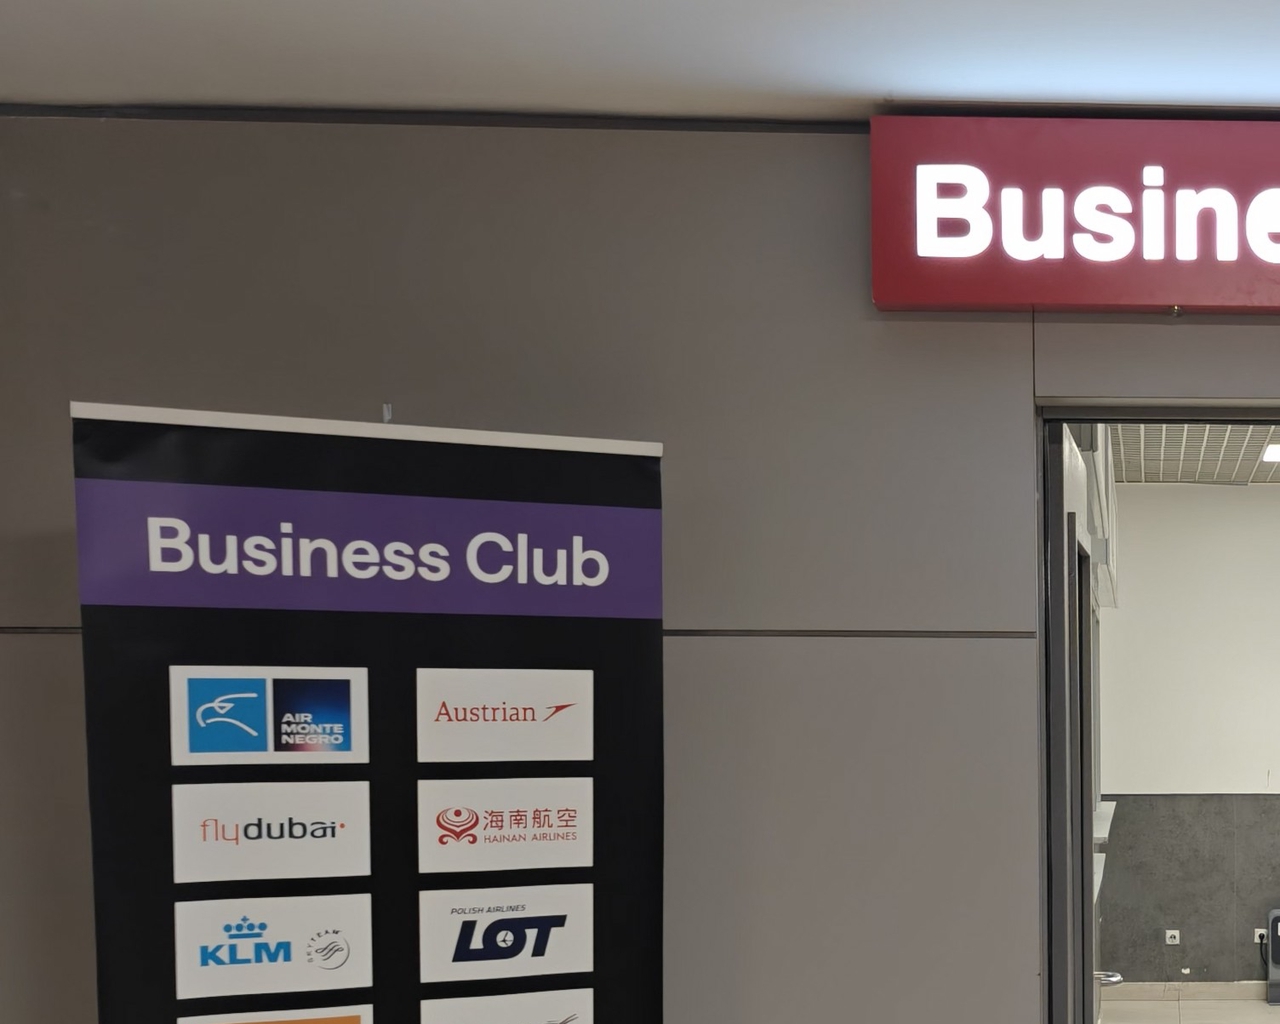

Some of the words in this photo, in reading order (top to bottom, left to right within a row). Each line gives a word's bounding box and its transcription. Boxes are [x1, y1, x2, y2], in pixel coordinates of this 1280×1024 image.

[147, 516, 451, 581] Business
[467, 532, 610, 586] Club
[281, 713, 313, 722] AIR
[434, 701, 537, 722] Austrian
[281, 723, 344, 734] MONTE
[281, 734, 344, 744] NEGRO
[483, 808, 578, 831] 海南航空
[199, 817, 337, 846] flydubai
[483, 833, 527, 844] HAINAN
[531, 832, 578, 842] AIRLINES
[450, 907, 485, 915] POLISH
[486, 904, 527, 913] AIRLINES
[451, 914, 568, 962] LOT
[199, 941, 292, 967] KLM
